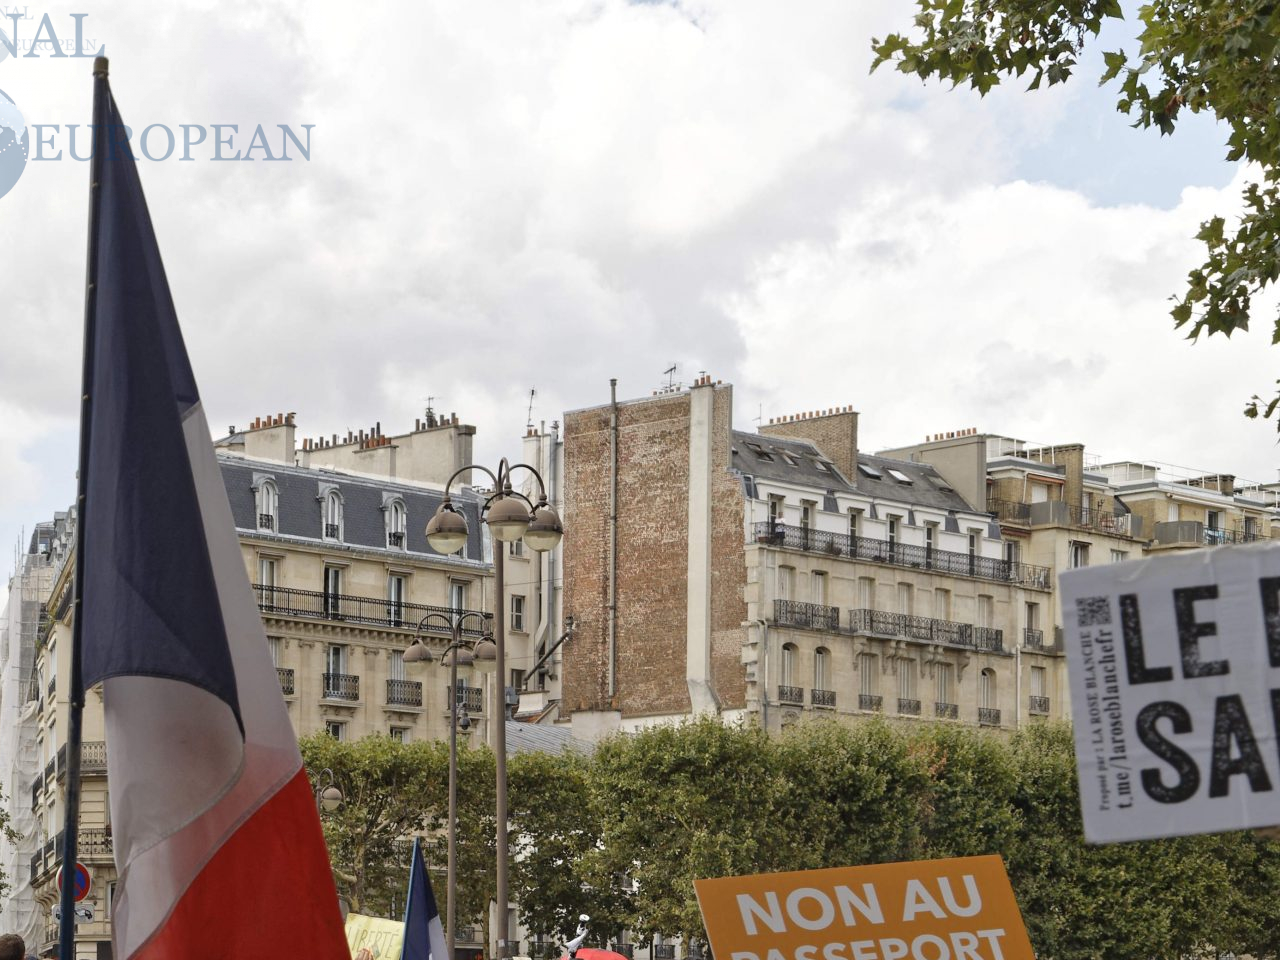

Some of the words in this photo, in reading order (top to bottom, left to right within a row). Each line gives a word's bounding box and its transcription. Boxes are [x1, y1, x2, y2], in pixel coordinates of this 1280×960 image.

[1080, 631, 1097, 689] BLANCHE
[1119, 584, 1231, 686] LE
[1087, 692, 1102, 725] ROSE
[1091, 728, 1104, 744] LA
[1095, 628, 1133, 810] t.me/laroseblanchefr
[1135, 686, 1280, 805] SA
[736, 882, 885, 936] NON
[902, 874, 983, 922] AU
